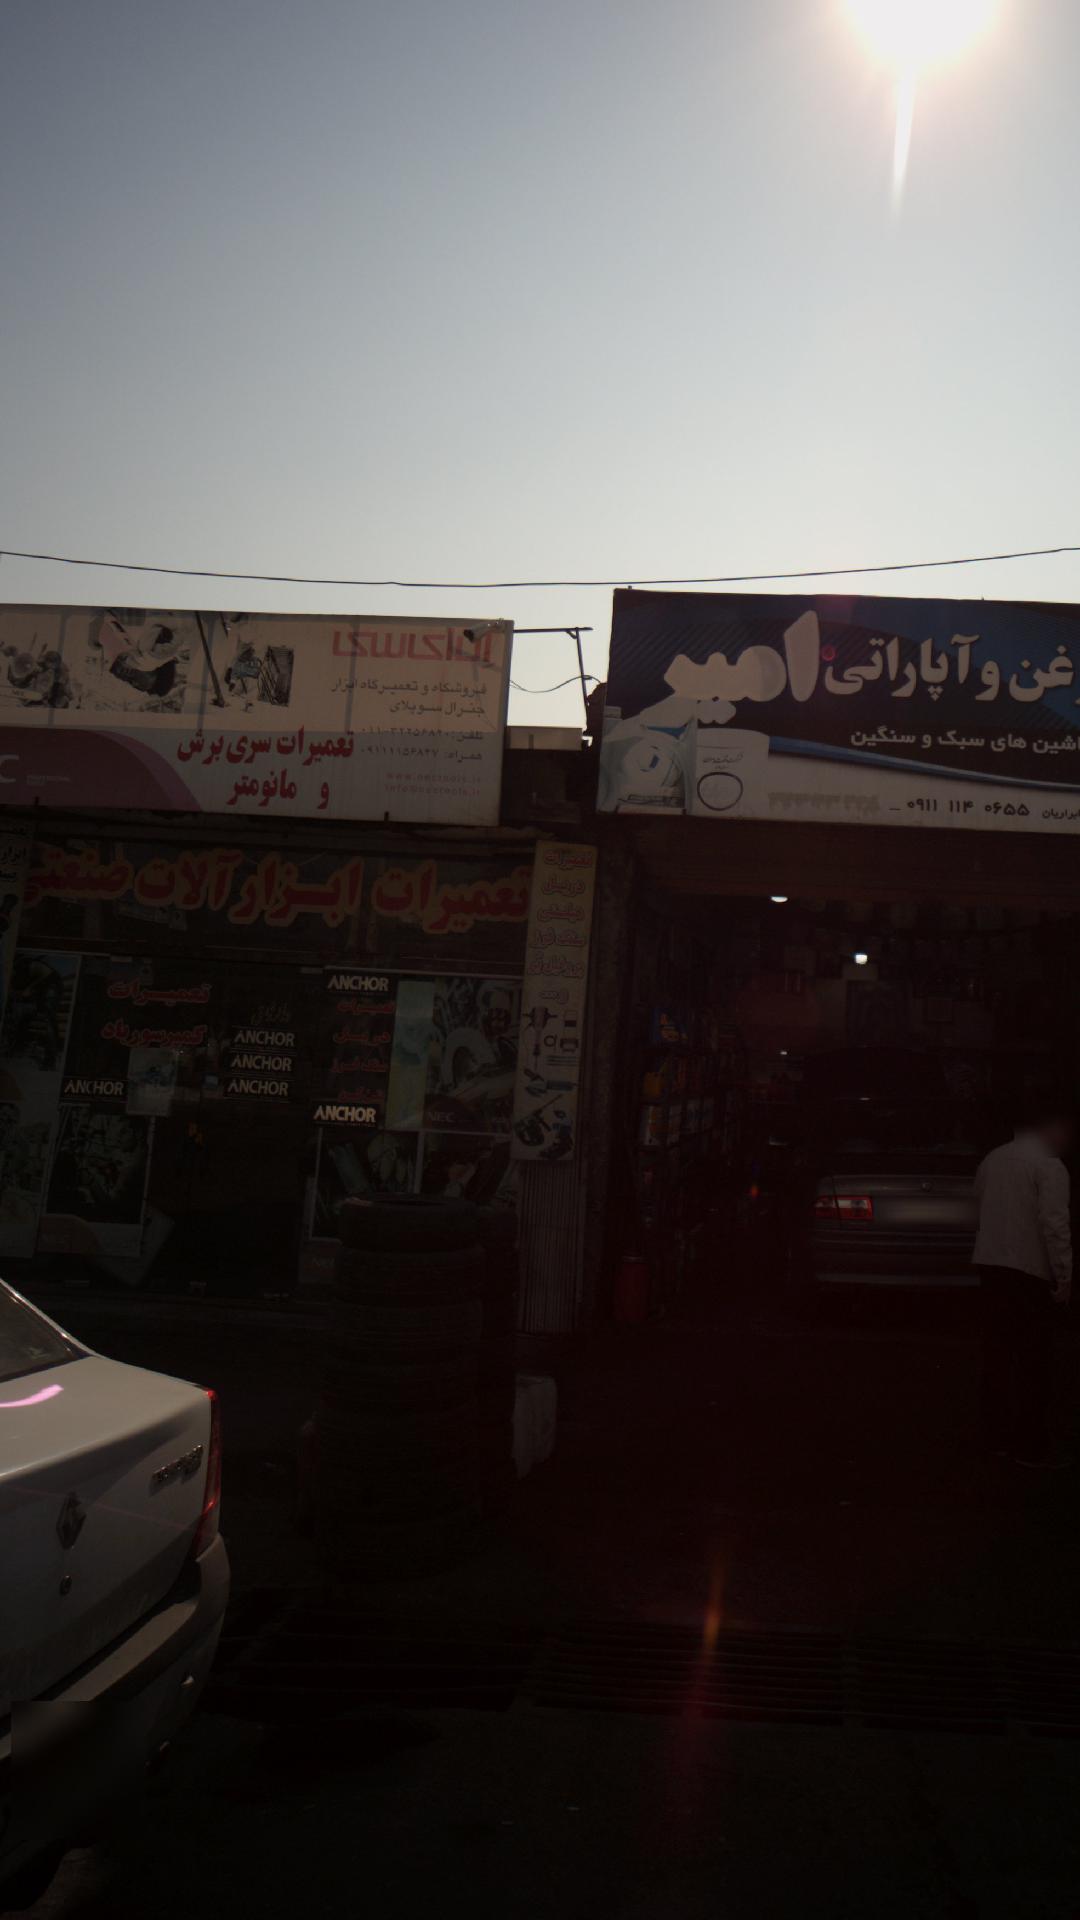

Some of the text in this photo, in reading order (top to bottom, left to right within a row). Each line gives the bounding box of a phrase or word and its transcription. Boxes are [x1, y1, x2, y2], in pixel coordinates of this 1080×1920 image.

[824, 633, 981, 702] آپاراتی
[974, 659, 1000, 702] و
[444, 702, 485, 716] جنرال
[176, 724, 355, 766] تعمیرات سری برش
[850, 724, 916, 747] سنگین
[921, 733, 932, 749] و
[936, 730, 985, 750] سبک
[990, 733, 1027, 751] های
[317, 780, 330, 809] و
[327, 974, 390, 992] ANCHOR
[233, 1029, 296, 1048] ANCHOR
[229, 1053, 293, 1072] ANCHOR
[64, 1079, 125, 1097] ANCHOR
[226, 1078, 289, 1097] ANCHOR
[312, 1104, 377, 1123] ANCHOR
